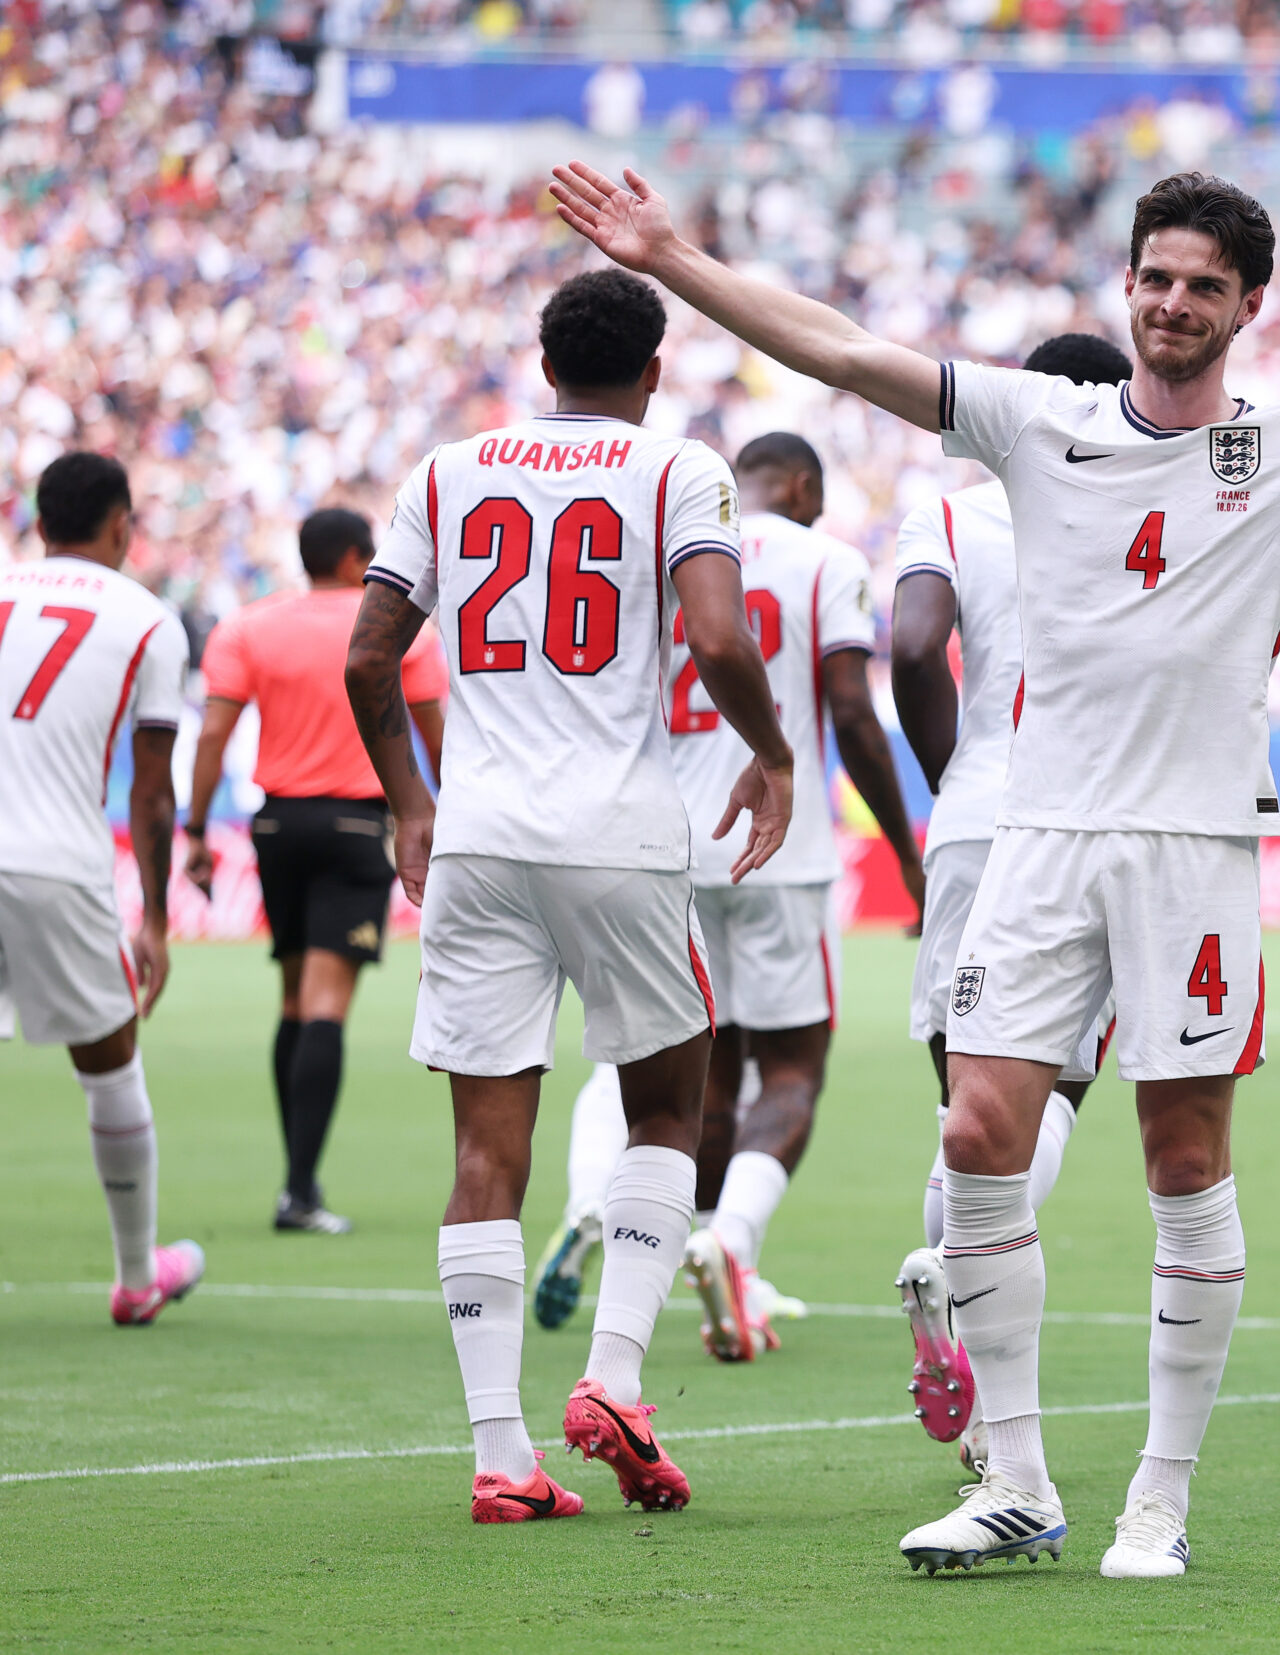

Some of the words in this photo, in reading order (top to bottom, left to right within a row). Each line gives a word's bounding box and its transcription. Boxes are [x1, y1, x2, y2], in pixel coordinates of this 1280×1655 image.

[478, 438, 632, 472] QUANSAH
[1216, 490, 1251, 501] FRANCE
[1216, 502, 1248, 512] 18.07.26
[1125, 511, 1166, 589] 4
[458, 496, 623, 676] 26
[0, 601, 97, 722] 7
[1187, 934, 1228, 1016] 4
[614, 1227, 661, 1249] ENG
[449, 1303, 483, 1320] ENG
